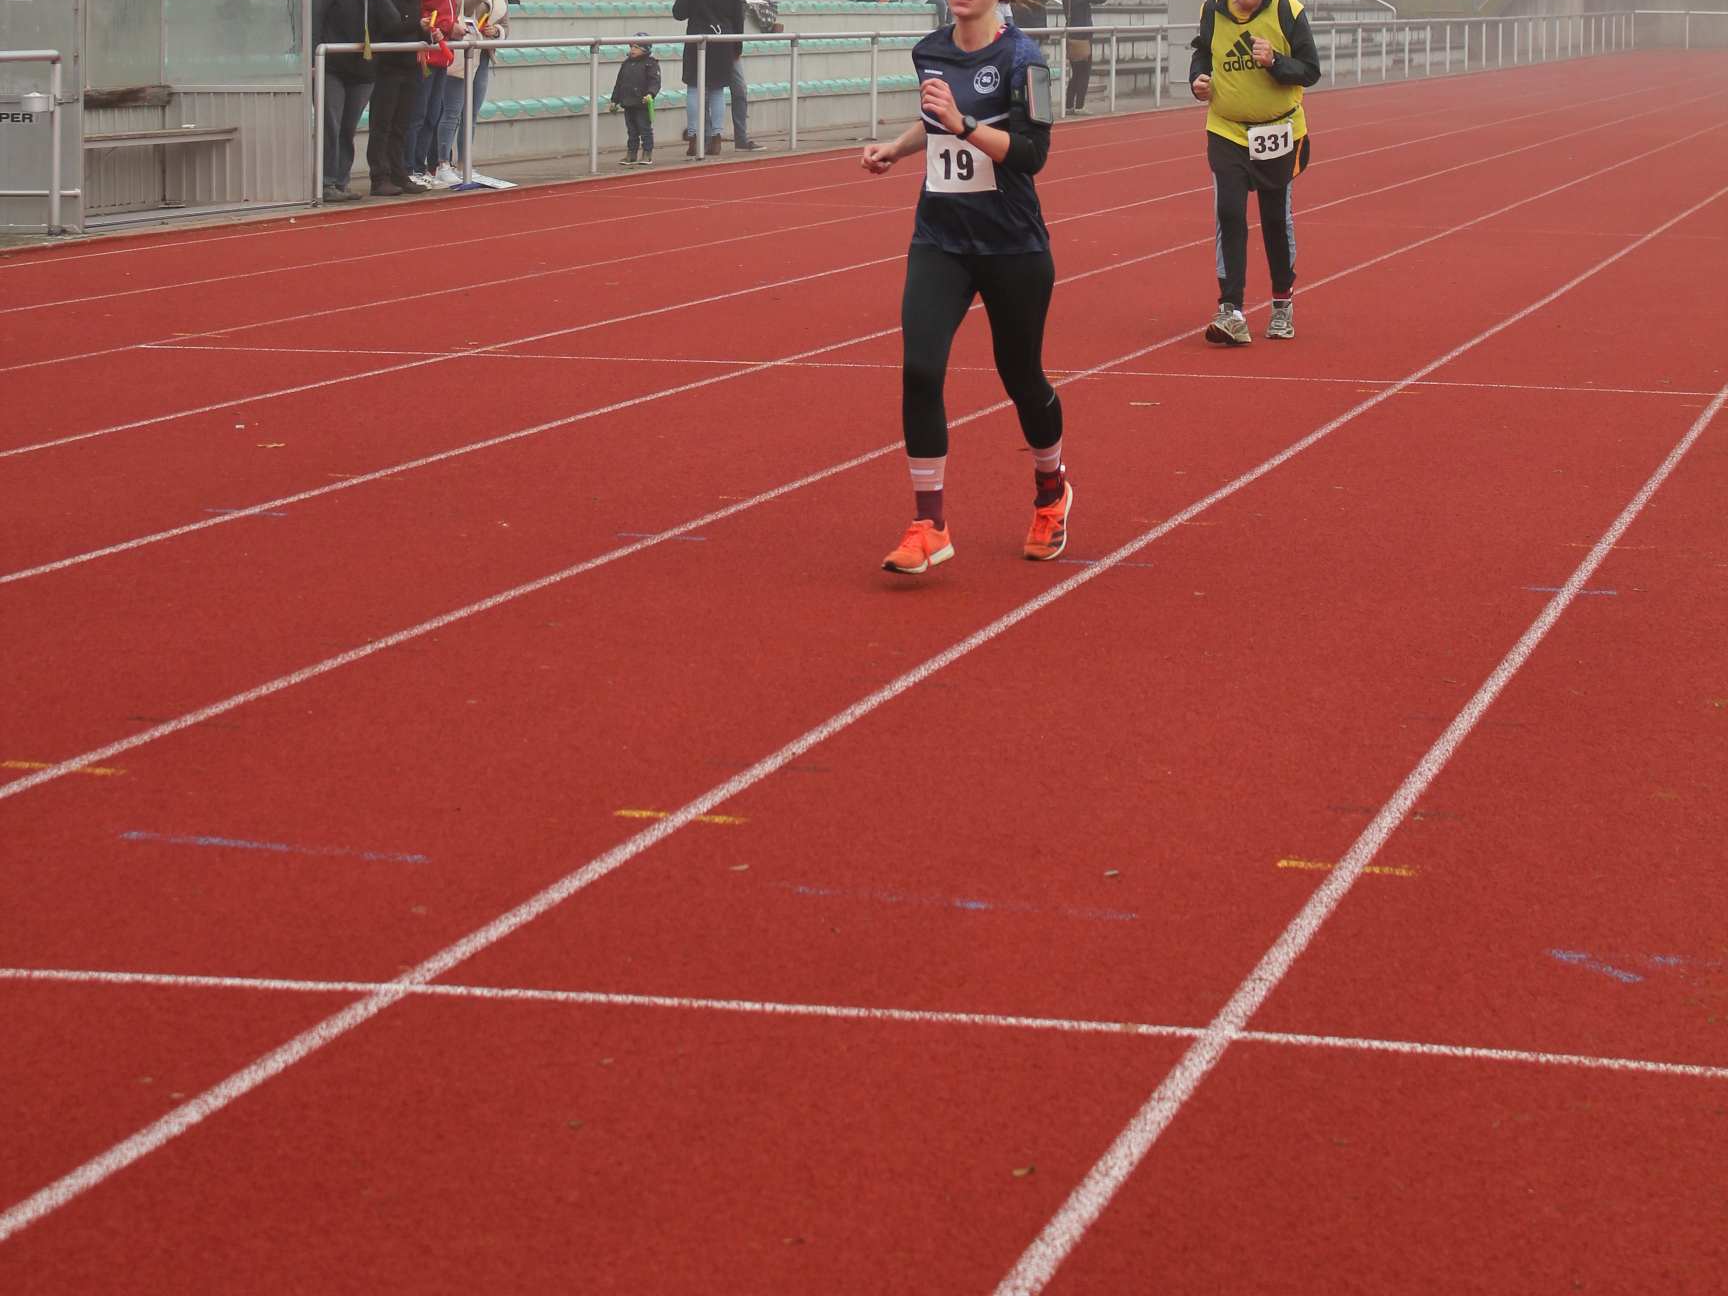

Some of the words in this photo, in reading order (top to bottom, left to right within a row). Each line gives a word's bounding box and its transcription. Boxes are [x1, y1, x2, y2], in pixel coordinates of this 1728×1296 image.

[0, 112, 33, 123] PER
[1254, 131, 1289, 154] 331
[939, 148, 975, 181] 19
